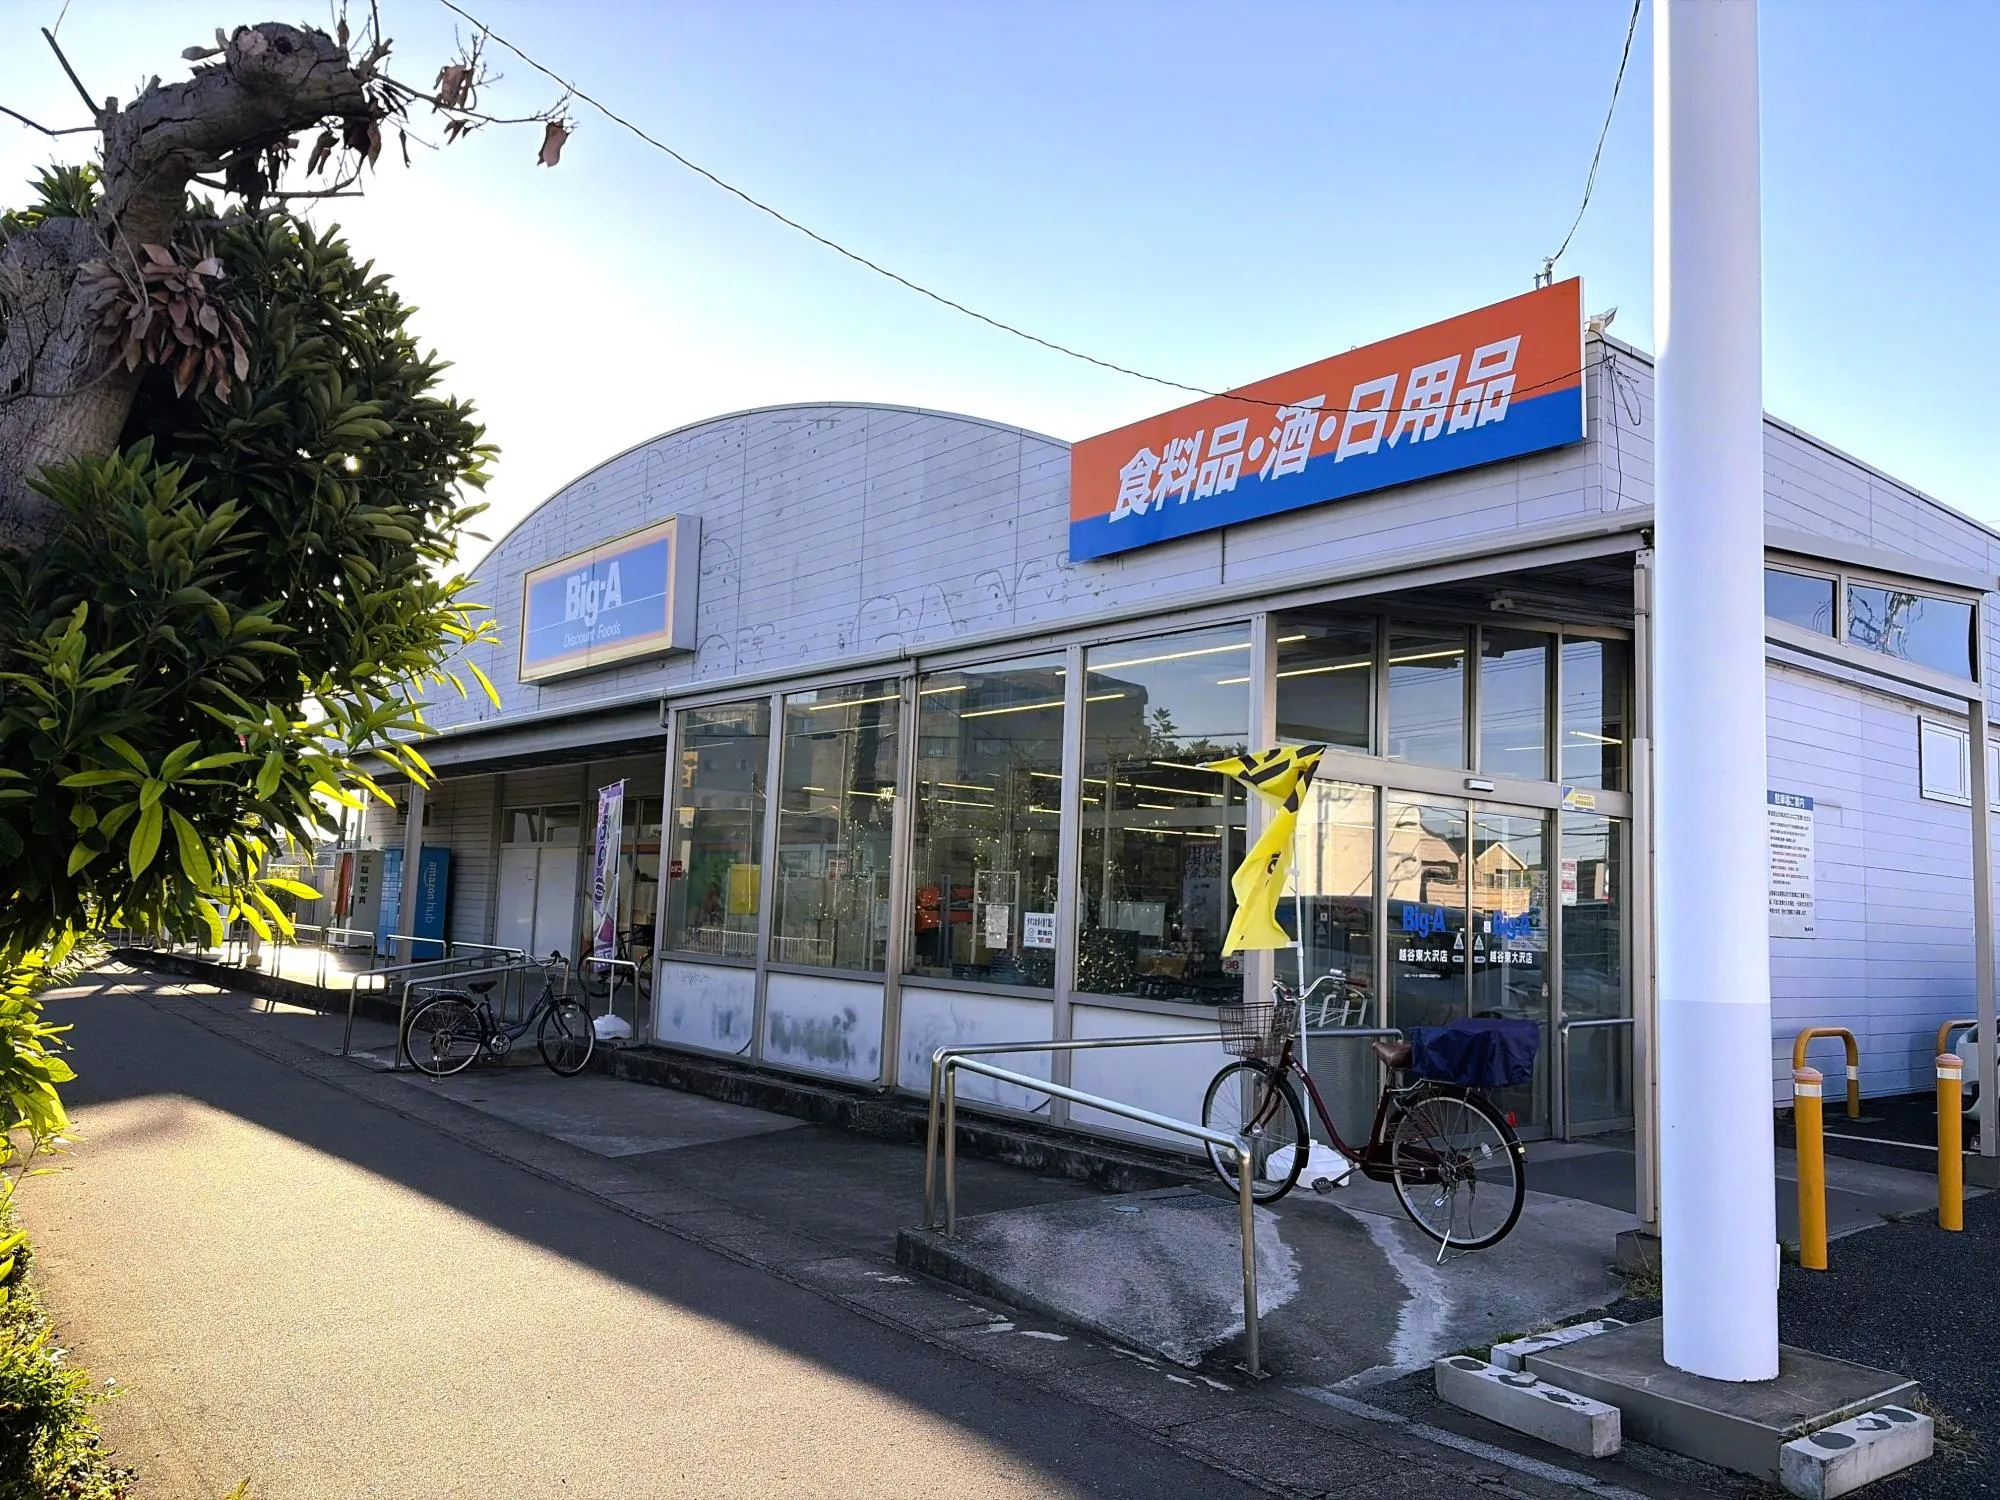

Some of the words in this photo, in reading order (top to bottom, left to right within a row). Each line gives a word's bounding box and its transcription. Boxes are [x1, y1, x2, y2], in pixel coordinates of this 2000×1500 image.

[563, 629, 595, 648] Discount
[597, 620, 621, 640] Foods
[427, 861, 437, 899] amazon
[425, 903, 437, 923] hub
[1398, 948, 1448, 962] 越谷東大沢店
[1489, 950, 1533, 964] 越谷東大沢店
